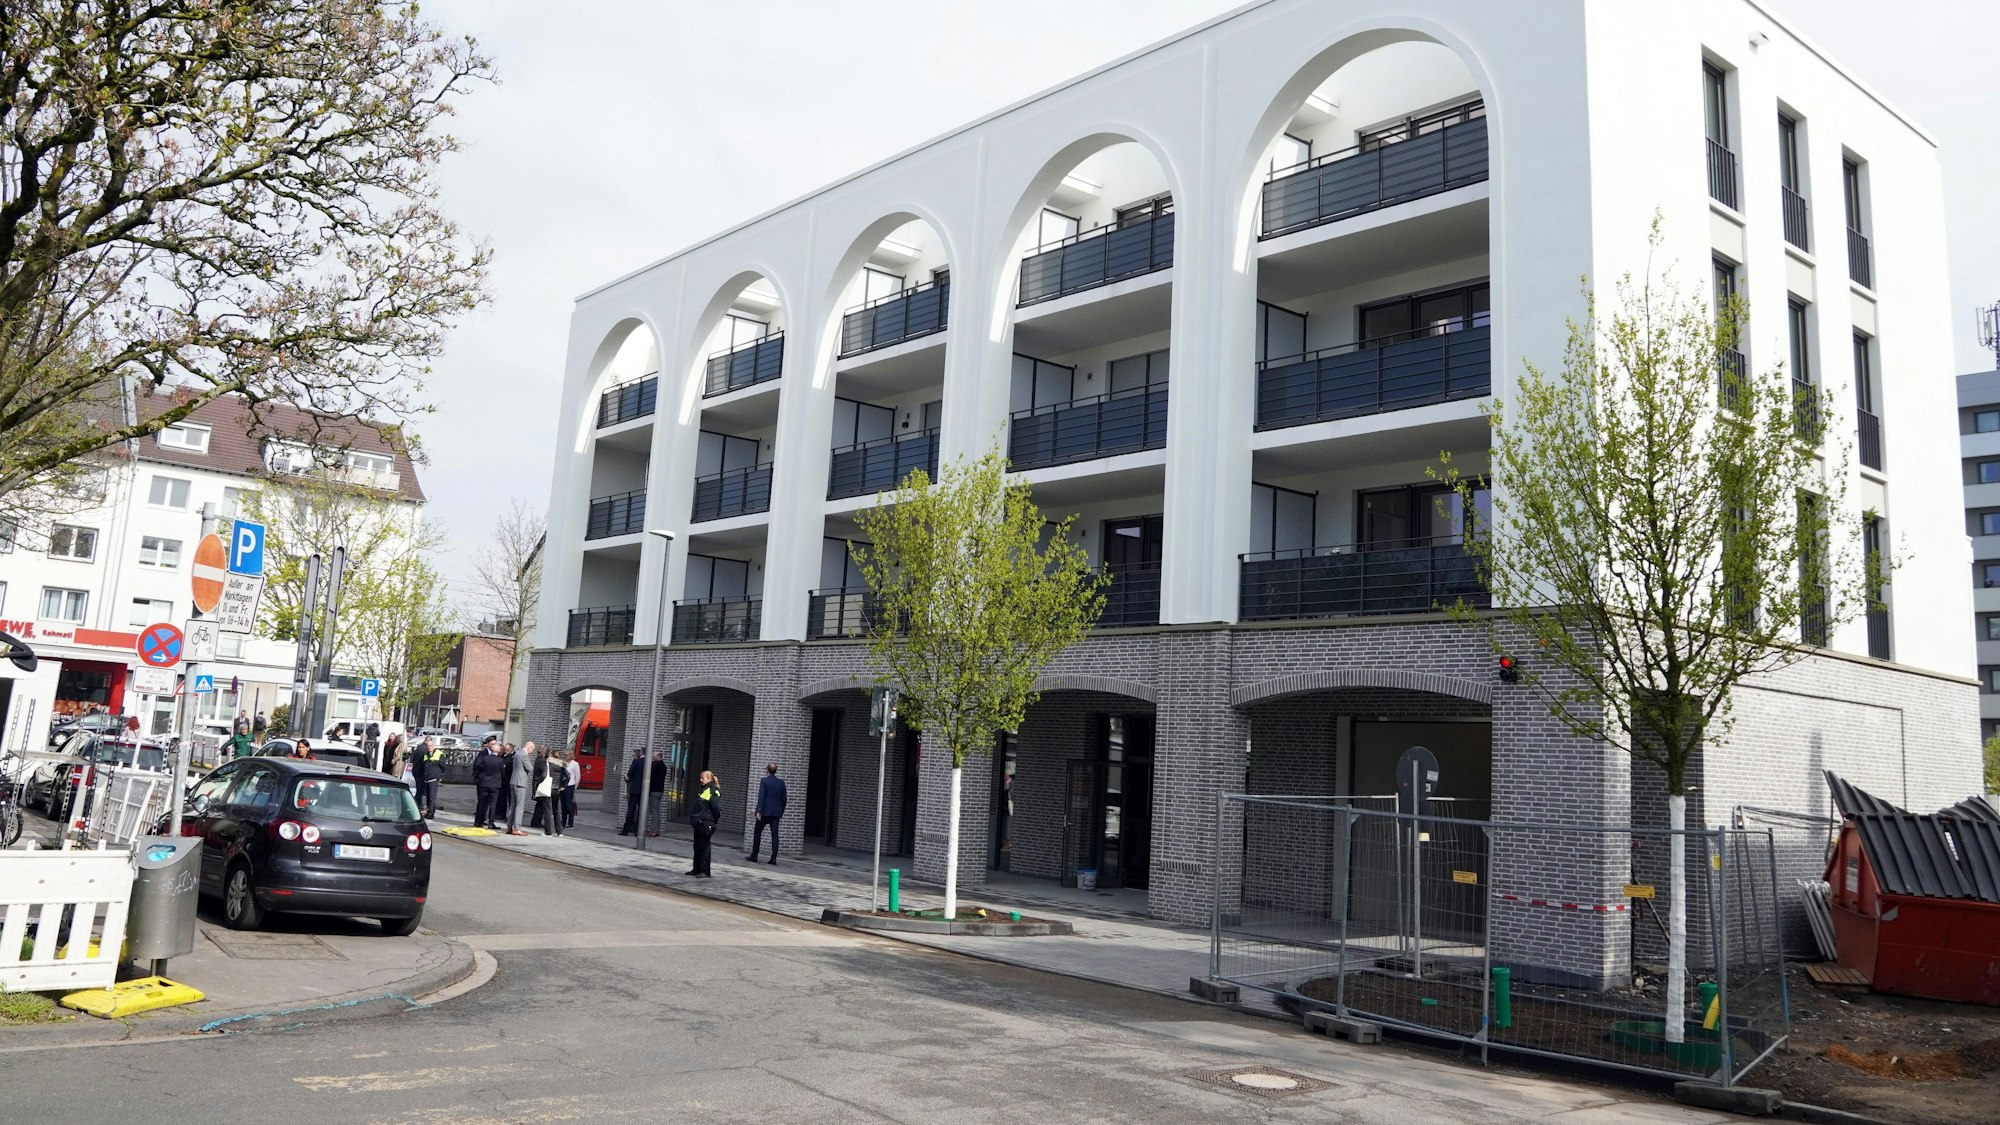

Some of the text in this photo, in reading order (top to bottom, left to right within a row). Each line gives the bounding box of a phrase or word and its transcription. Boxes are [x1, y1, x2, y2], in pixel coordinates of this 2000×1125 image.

[236, 527, 256, 567] P
[228, 579, 254, 591] Außer an
[224, 590, 252, 604] Markttagen
[229, 604, 239, 613] und
[0, 619, 34, 634] EWE
[365, 681, 375, 694] P
